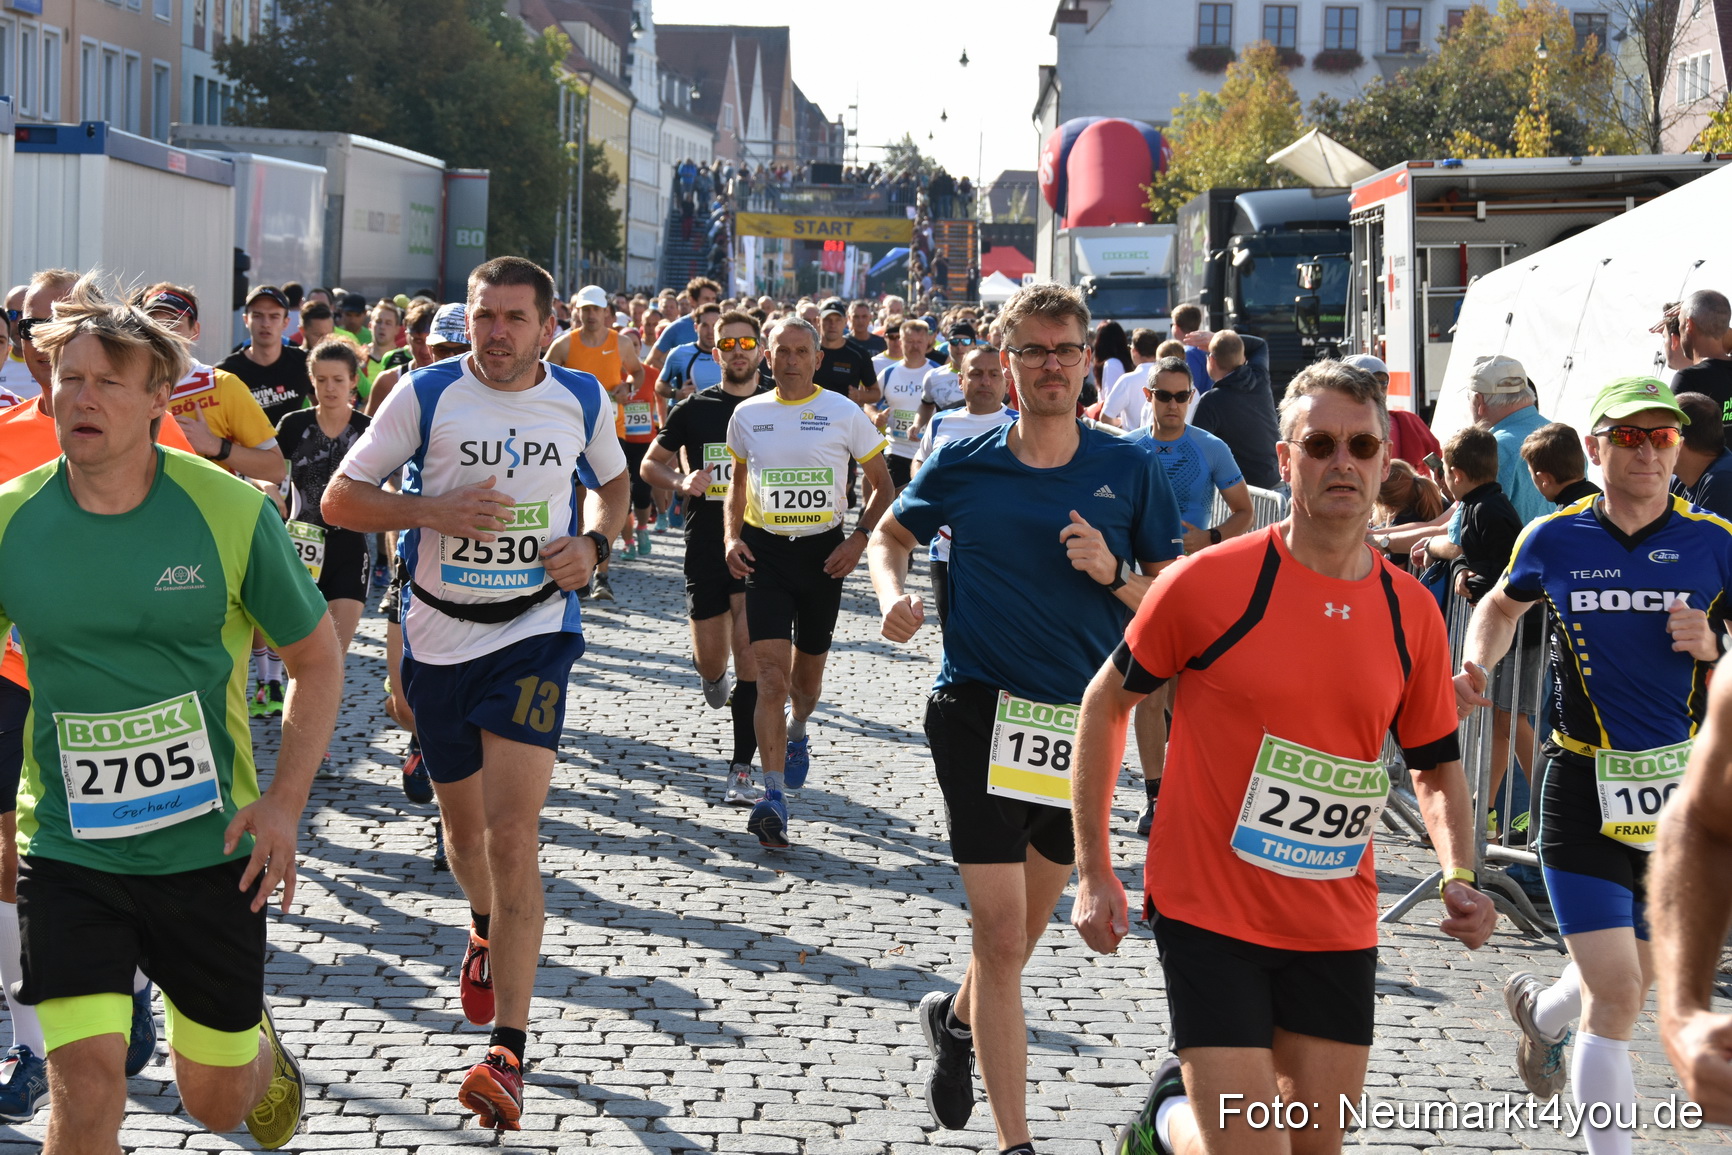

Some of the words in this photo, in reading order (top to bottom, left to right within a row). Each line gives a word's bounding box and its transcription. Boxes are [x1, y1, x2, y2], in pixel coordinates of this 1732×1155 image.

[794, 219, 855, 236] START
[171, 395, 220, 416] BÖGL
[627, 413, 648, 424] 799
[767, 470, 828, 484] BOCK
[770, 490, 826, 509] 1209
[774, 515, 821, 523] EDMUND
[451, 535, 539, 564] 2530
[156, 564, 204, 585] AOK
[458, 572, 529, 586] JOHANN
[1570, 569, 1621, 579] TEAM
[1570, 590, 1691, 612] BOCK
[512, 675, 560, 733] 13
[66, 703, 190, 746] BOCK
[1008, 732, 1072, 771] 138
[1607, 749, 1690, 776] BOCK
[76, 742, 195, 795] 2705
[1268, 745, 1381, 792] BOCK
[112, 795, 183, 820] Gerhard
[1258, 786, 1372, 839] 2298
[1261, 838, 1346, 866] THOMAS
